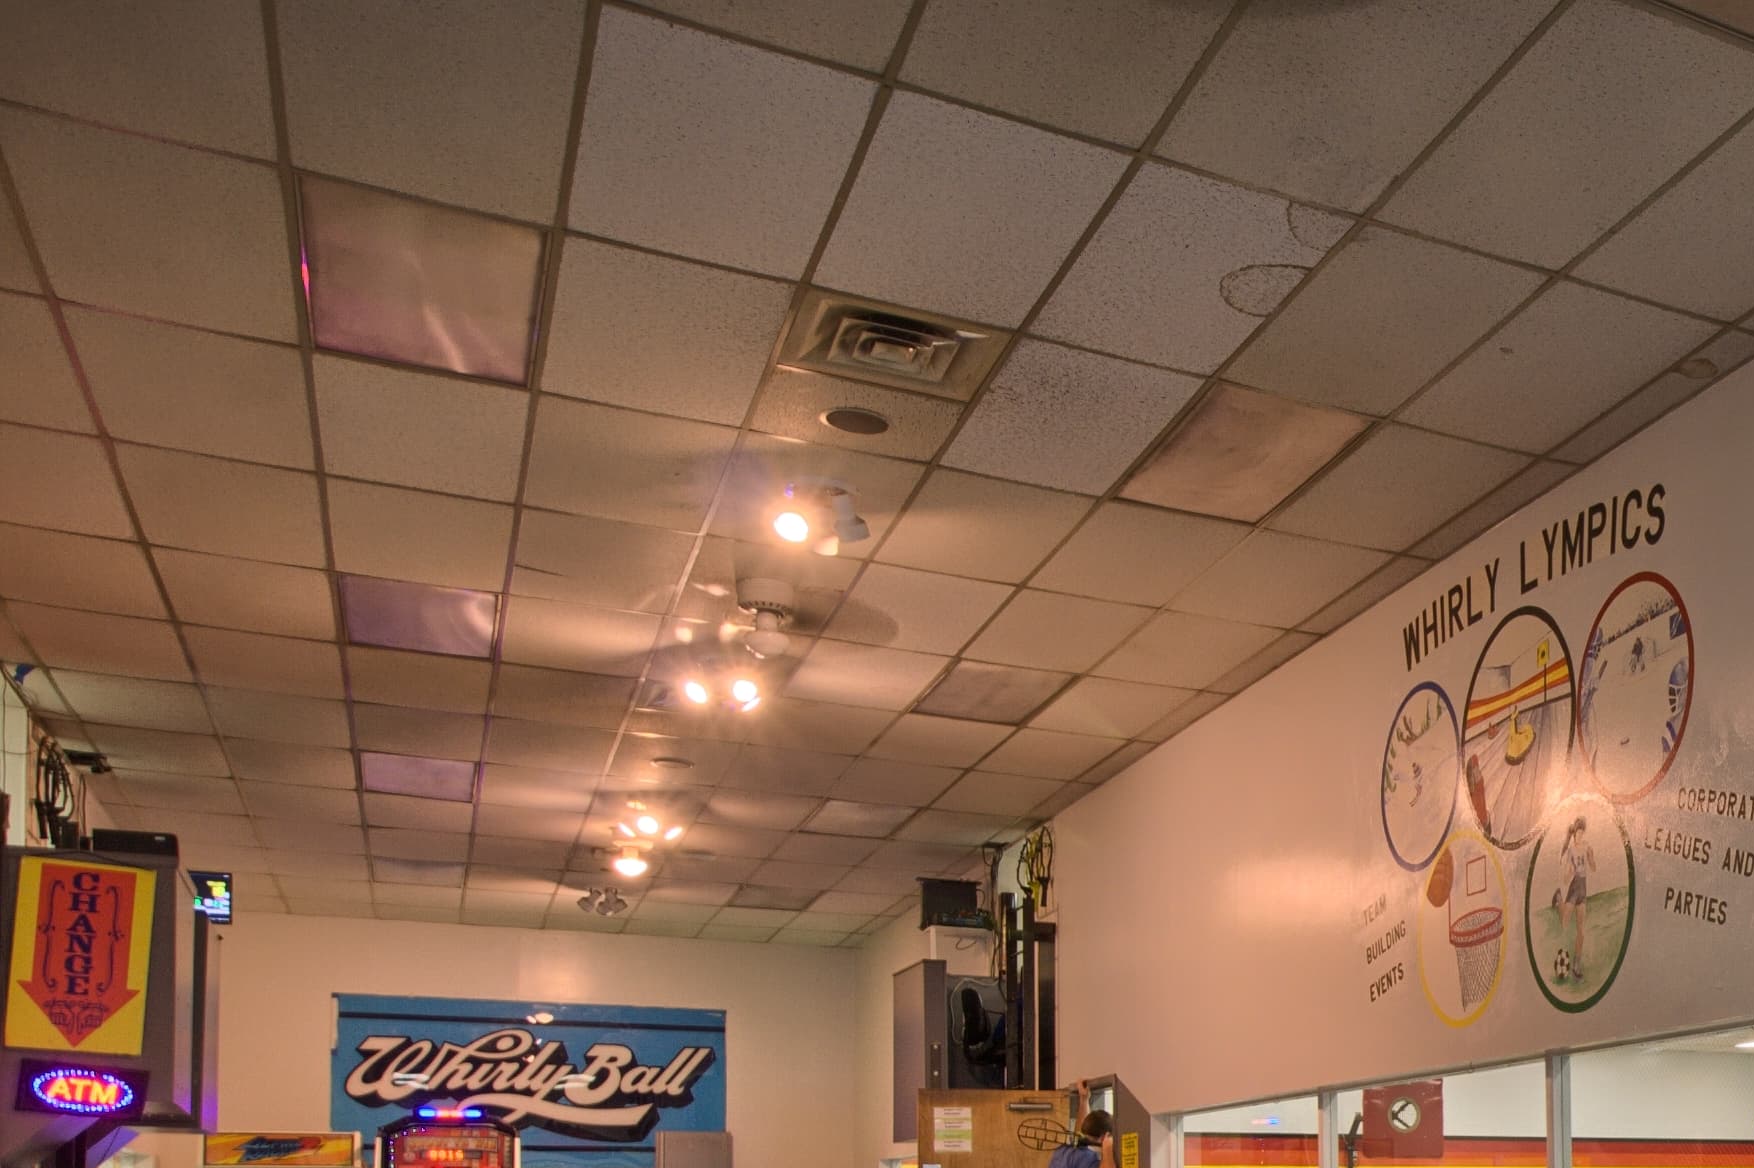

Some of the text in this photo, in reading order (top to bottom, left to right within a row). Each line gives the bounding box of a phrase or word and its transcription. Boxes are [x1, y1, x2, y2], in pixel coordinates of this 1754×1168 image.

[1403, 483, 1666, 672] WHIRLY LYMPICS
[1644, 828, 1754, 877] LEAGUES AND
[1363, 894, 1386, 926] TEAM
[1664, 887, 1727, 925] PARTIES
[64, 872, 100, 996] CHANGE
[1366, 919, 1406, 965] BUILDING
[1369, 962, 1404, 1003] EVENTS
[49, 1077, 120, 1105] ATM
[344, 1028, 715, 1108] Whirly Ball
